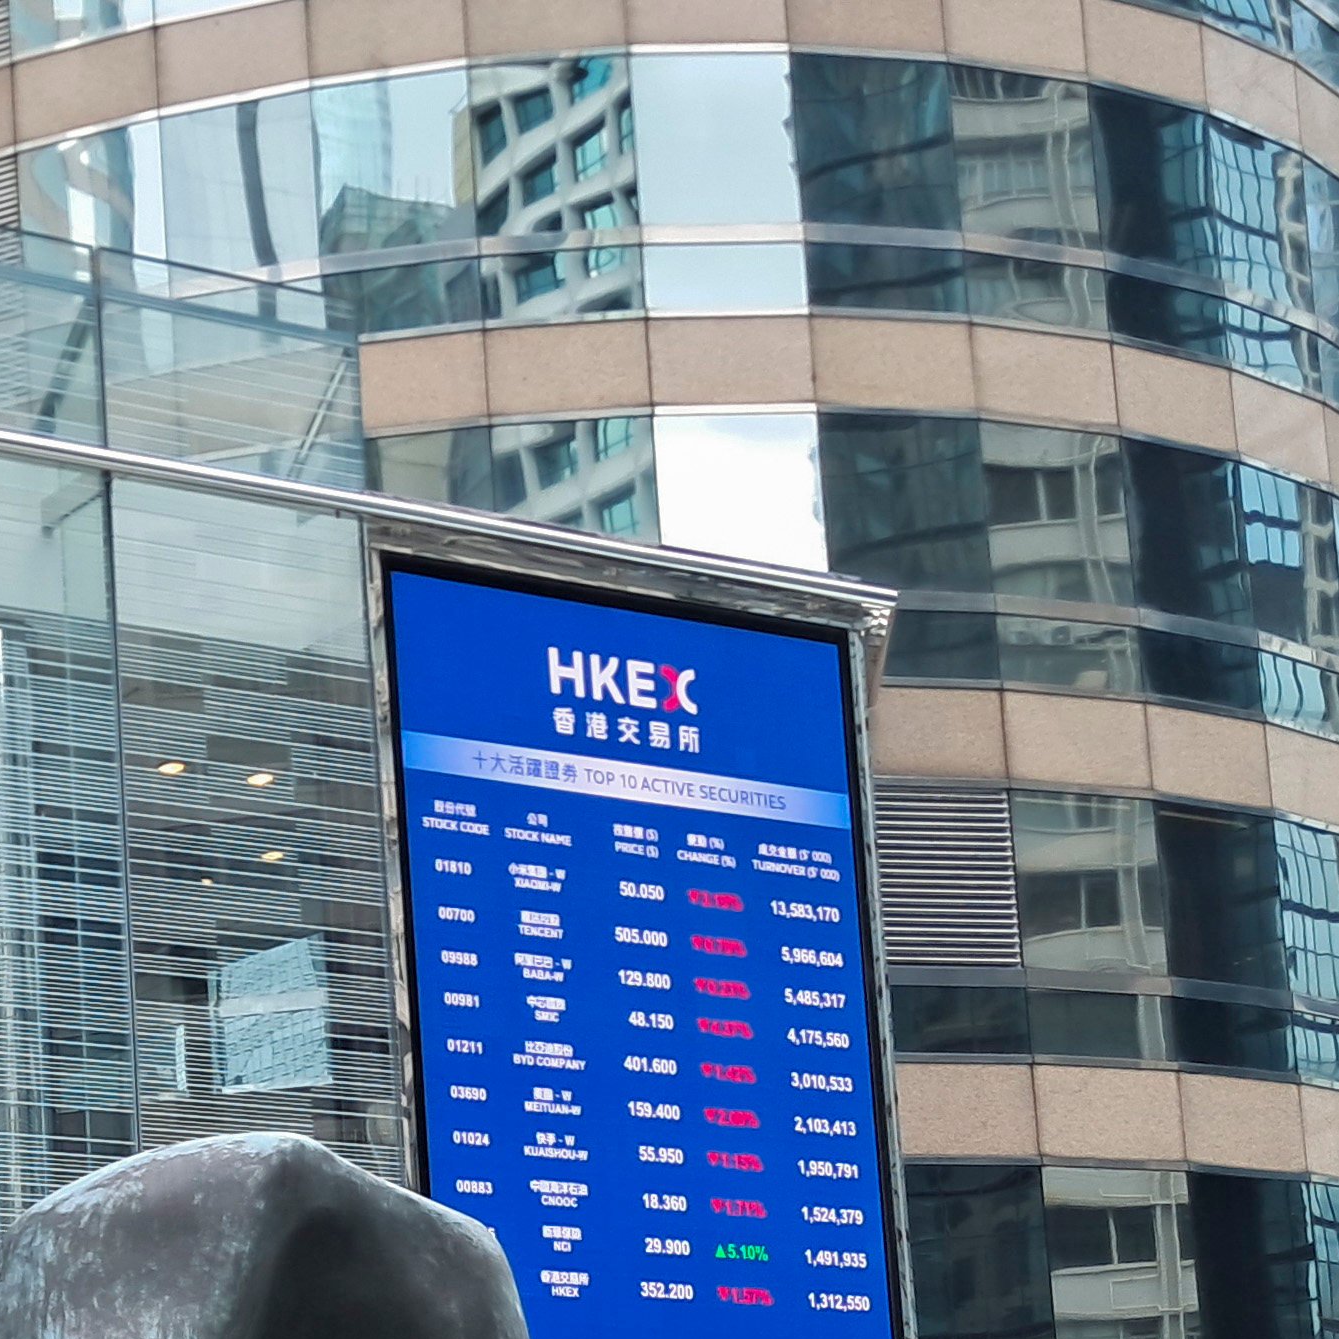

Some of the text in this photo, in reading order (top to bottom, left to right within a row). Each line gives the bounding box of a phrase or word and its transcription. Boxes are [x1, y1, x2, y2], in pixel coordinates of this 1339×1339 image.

[547, 646, 699, 715] HKEX
[552, 706, 700, 754] 香港交易所
[584, 768, 615, 786] TOP
[621, 774, 638, 790] 10
[641, 776, 696, 800] ACTIVE
[699, 785, 786, 811] SECURITIES
[619, 880, 665, 901] 50.050
[770, 900, 840, 923] 13,583,170
[614, 926, 668, 948] 505.000
[781, 946, 844, 968] 5,966,604
[617, 969, 671, 990] 129.800
[784, 987, 846, 1009] 5,485,317
[628, 1011, 674, 1030] 48.150
[447, 1038, 483, 1055] 01211
[787, 1027, 850, 1049] 4,175,560
[623, 1055, 678, 1076] 401.600
[790, 1071, 853, 1093] 3,010,533
[450, 1085, 487, 1101] 03690
[627, 1100, 681, 1121] 159.400
[794, 1116, 857, 1137] 2,103,413
[452, 1130, 491, 1147] 01024
[638, 1145, 684, 1165] 55.950
[797, 1159, 859, 1179] 1,950,791
[642, 1193, 687, 1212] 18.360
[801, 1206, 864, 1226] 1,524,379
[644, 1237, 691, 1256] 29.900
[804, 1249, 868, 1269] 1,491,935
[640, 1281, 694, 1300] 352.200
[808, 1292, 871, 1312] 1,312,550
